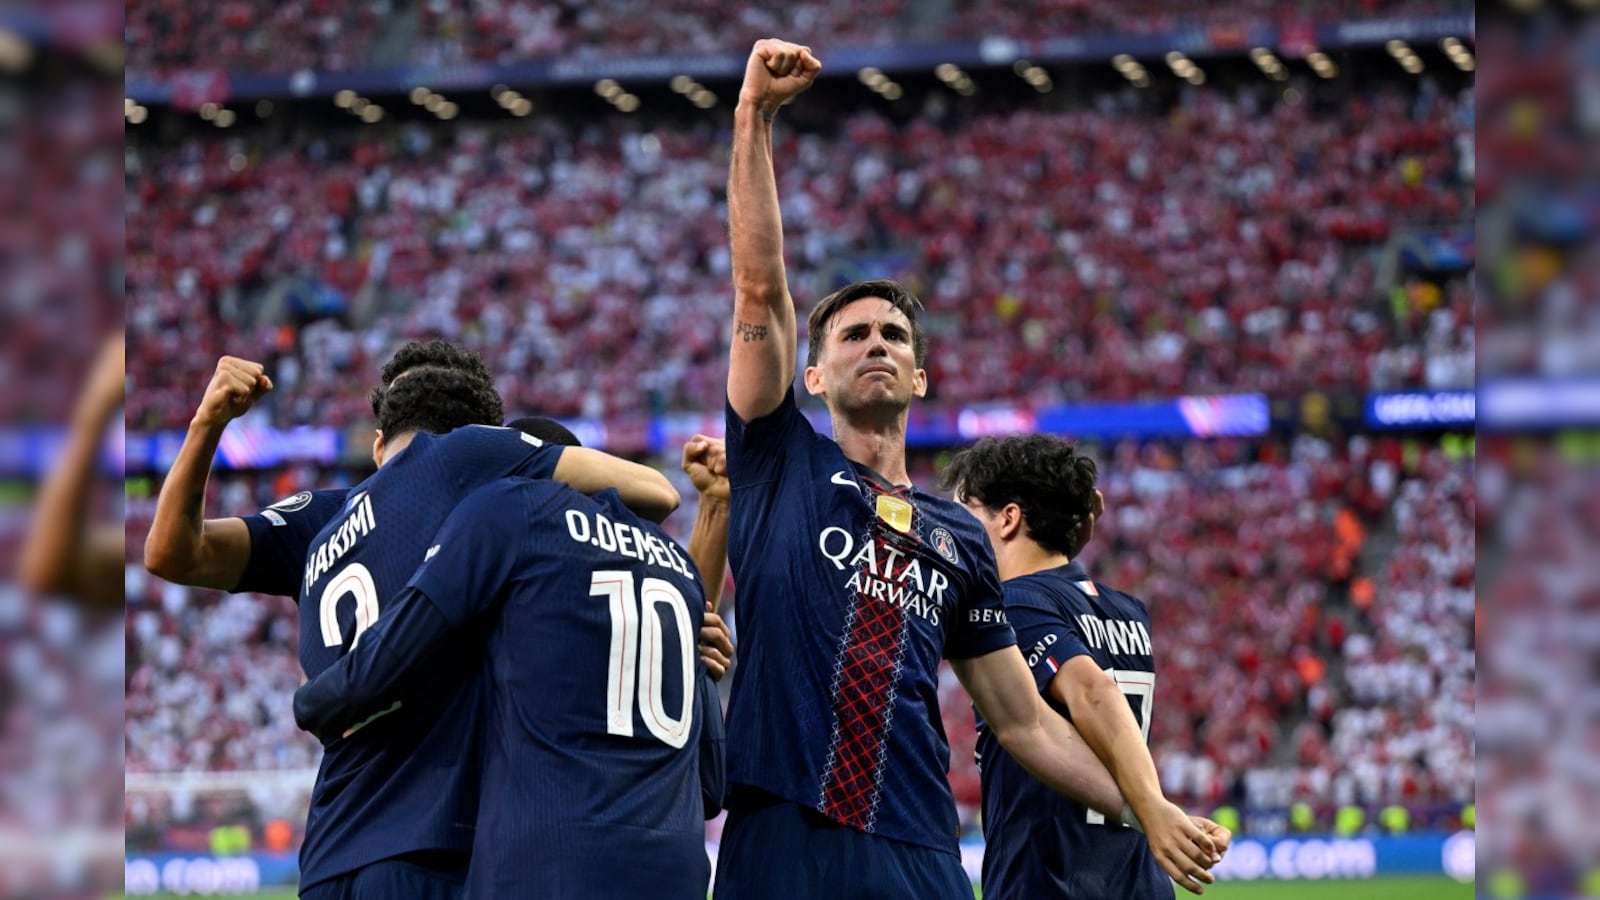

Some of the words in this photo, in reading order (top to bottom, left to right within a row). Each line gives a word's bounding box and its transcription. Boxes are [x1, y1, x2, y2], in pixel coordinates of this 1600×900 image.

[305, 494, 376, 597] HAKIMI
[819, 526, 949, 607] QATAR
[844, 571, 941, 626] AIRWAYS
[589, 570, 695, 749] 10
